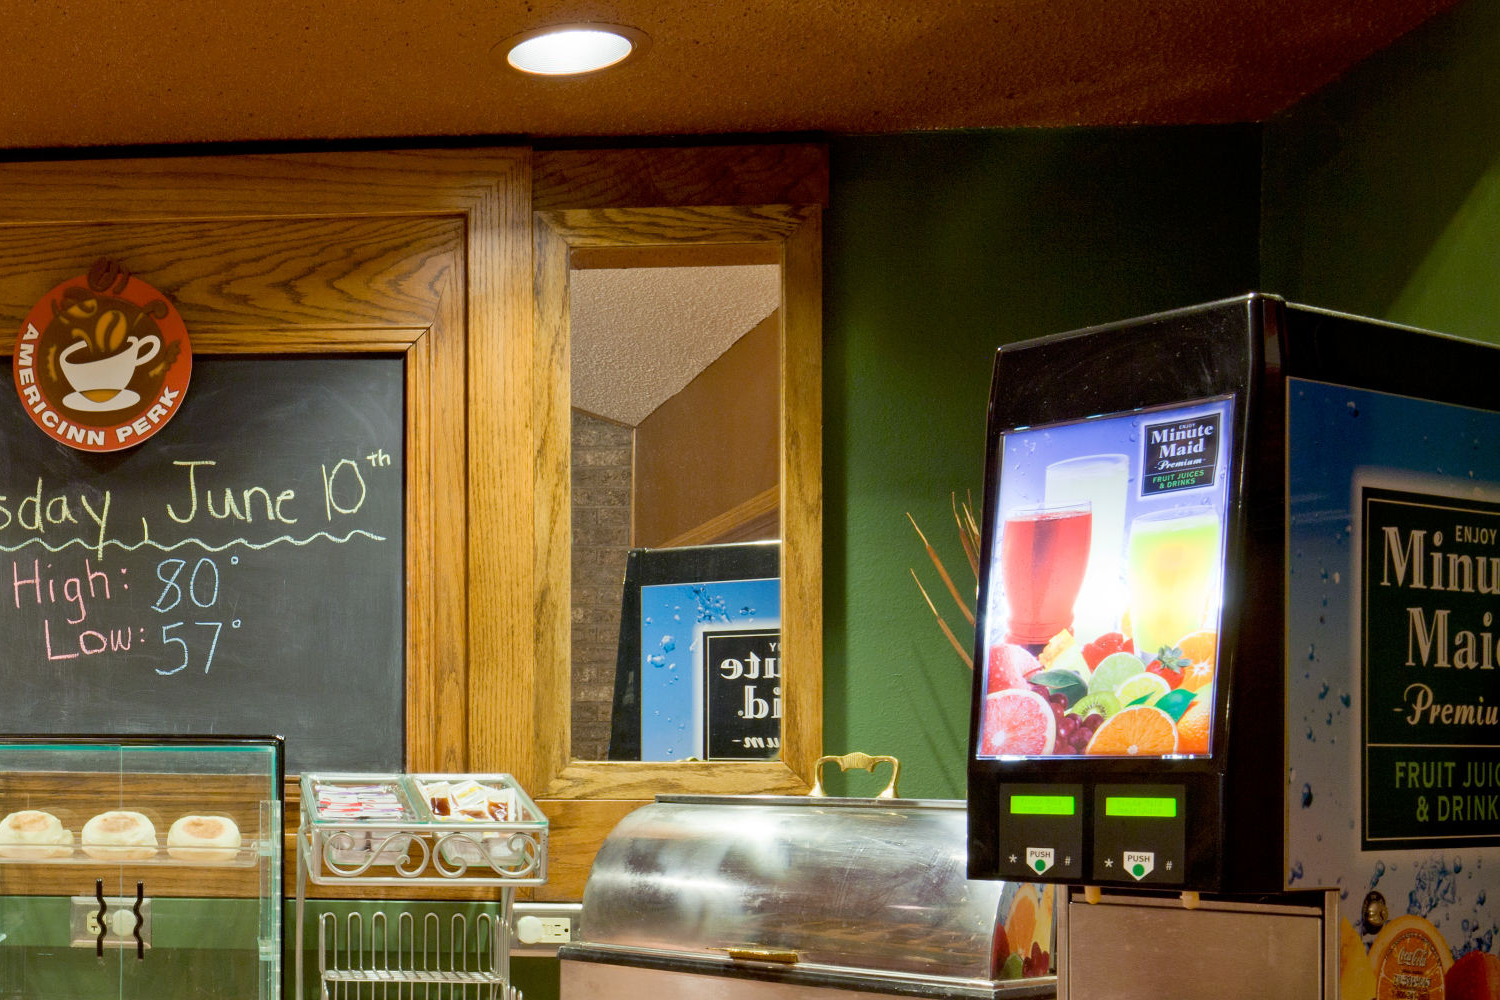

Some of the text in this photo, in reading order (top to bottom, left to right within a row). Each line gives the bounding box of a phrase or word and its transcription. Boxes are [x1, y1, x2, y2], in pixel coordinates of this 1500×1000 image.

[18, 323, 180, 446] AMERICINN PERK
[1151, 424, 1214, 445] Minute
[1159, 438, 1205, 459] Maid
[1153, 470, 1205, 484] FRUIT JUICES
[1167, 478, 1196, 488] DRINKS
[167, 460, 298, 524] June
[1455, 524, 1498, 546] ENJOY
[1380, 526, 1500, 595] Minu
[12, 558, 129, 624] High:
[44, 619, 146, 661] Low:
[1405, 607, 1500, 670] Mai
[1395, 761, 1456, 789] FRUIT
[1416, 795, 1499, 823] & DRINK
[1030, 851, 1051, 859] PUSH
[1127, 854, 1151, 862] PUSH
